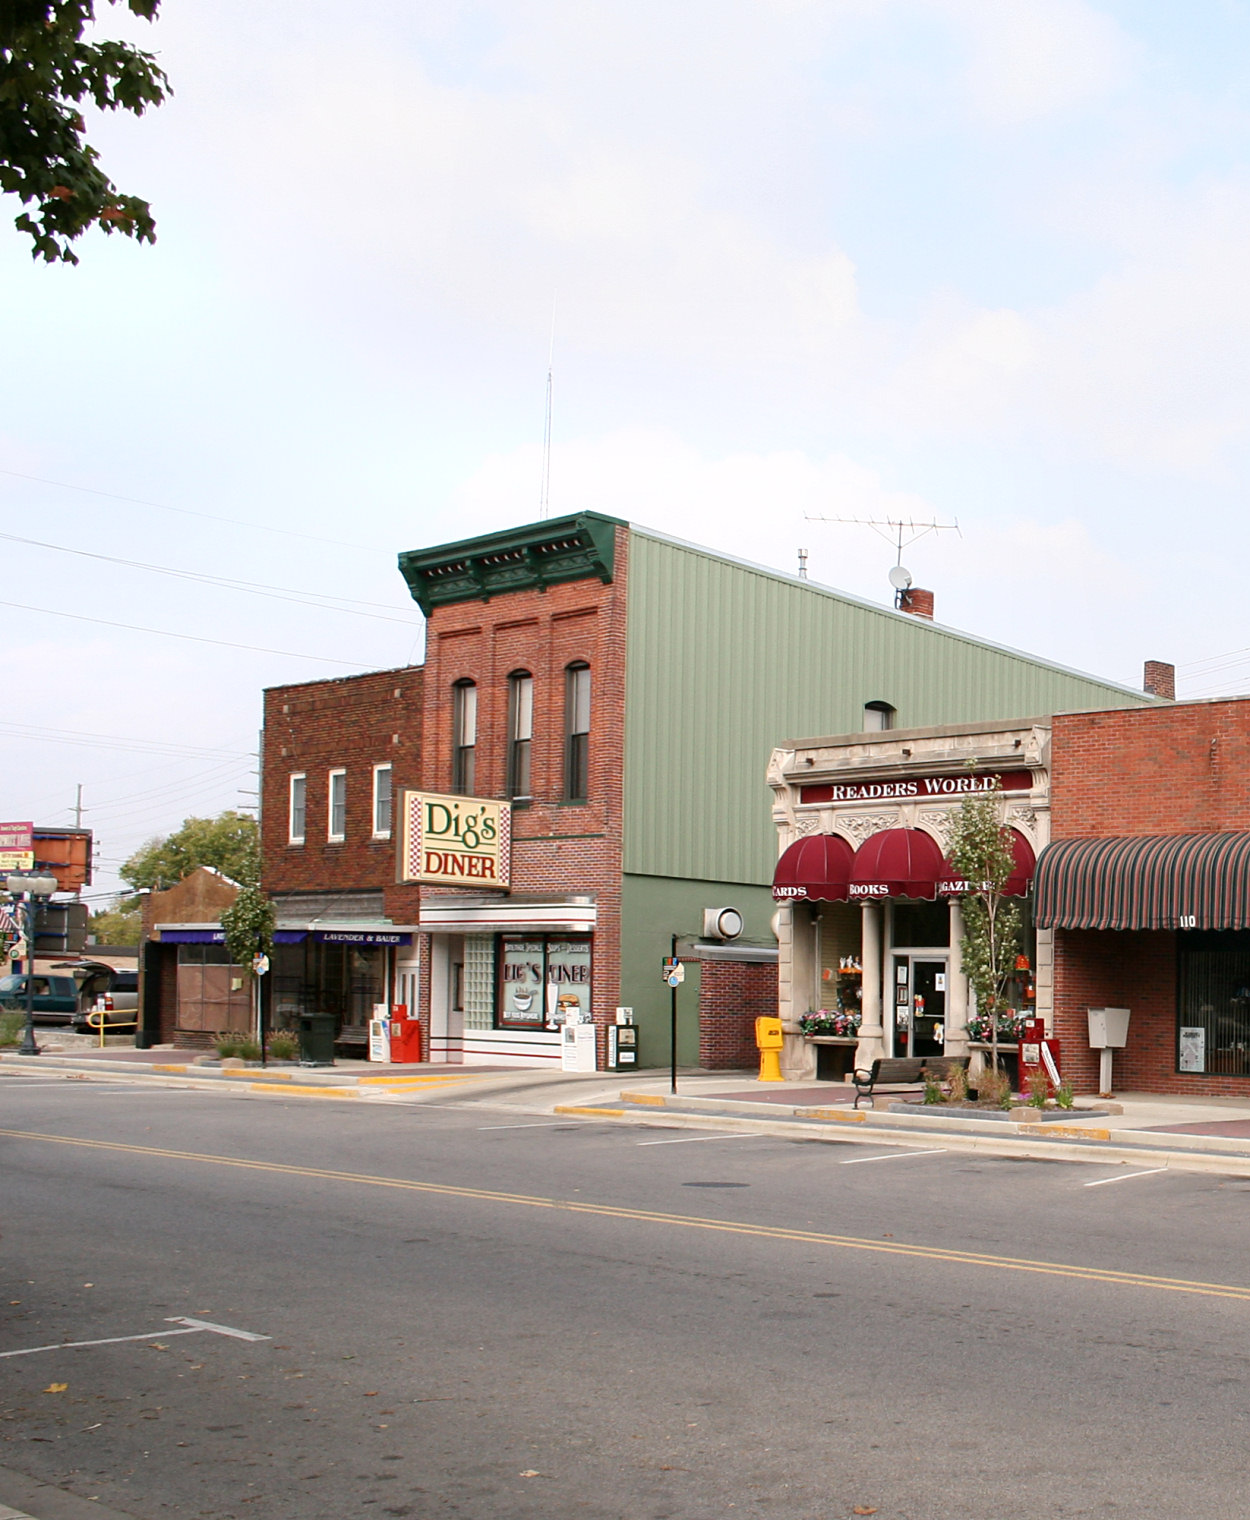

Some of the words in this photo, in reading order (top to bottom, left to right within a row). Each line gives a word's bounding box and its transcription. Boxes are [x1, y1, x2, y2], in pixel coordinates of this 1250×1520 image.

[832, 782, 918, 800] READERS
[924, 777, 996, 793] WORLD
[425, 802, 496, 849] Dig's
[424, 851, 496, 878] DINER
[849, 884, 889, 895] BOOKS
[1180, 915, 1196, 928] 110
[323, 933, 364, 942] LAVENDER
